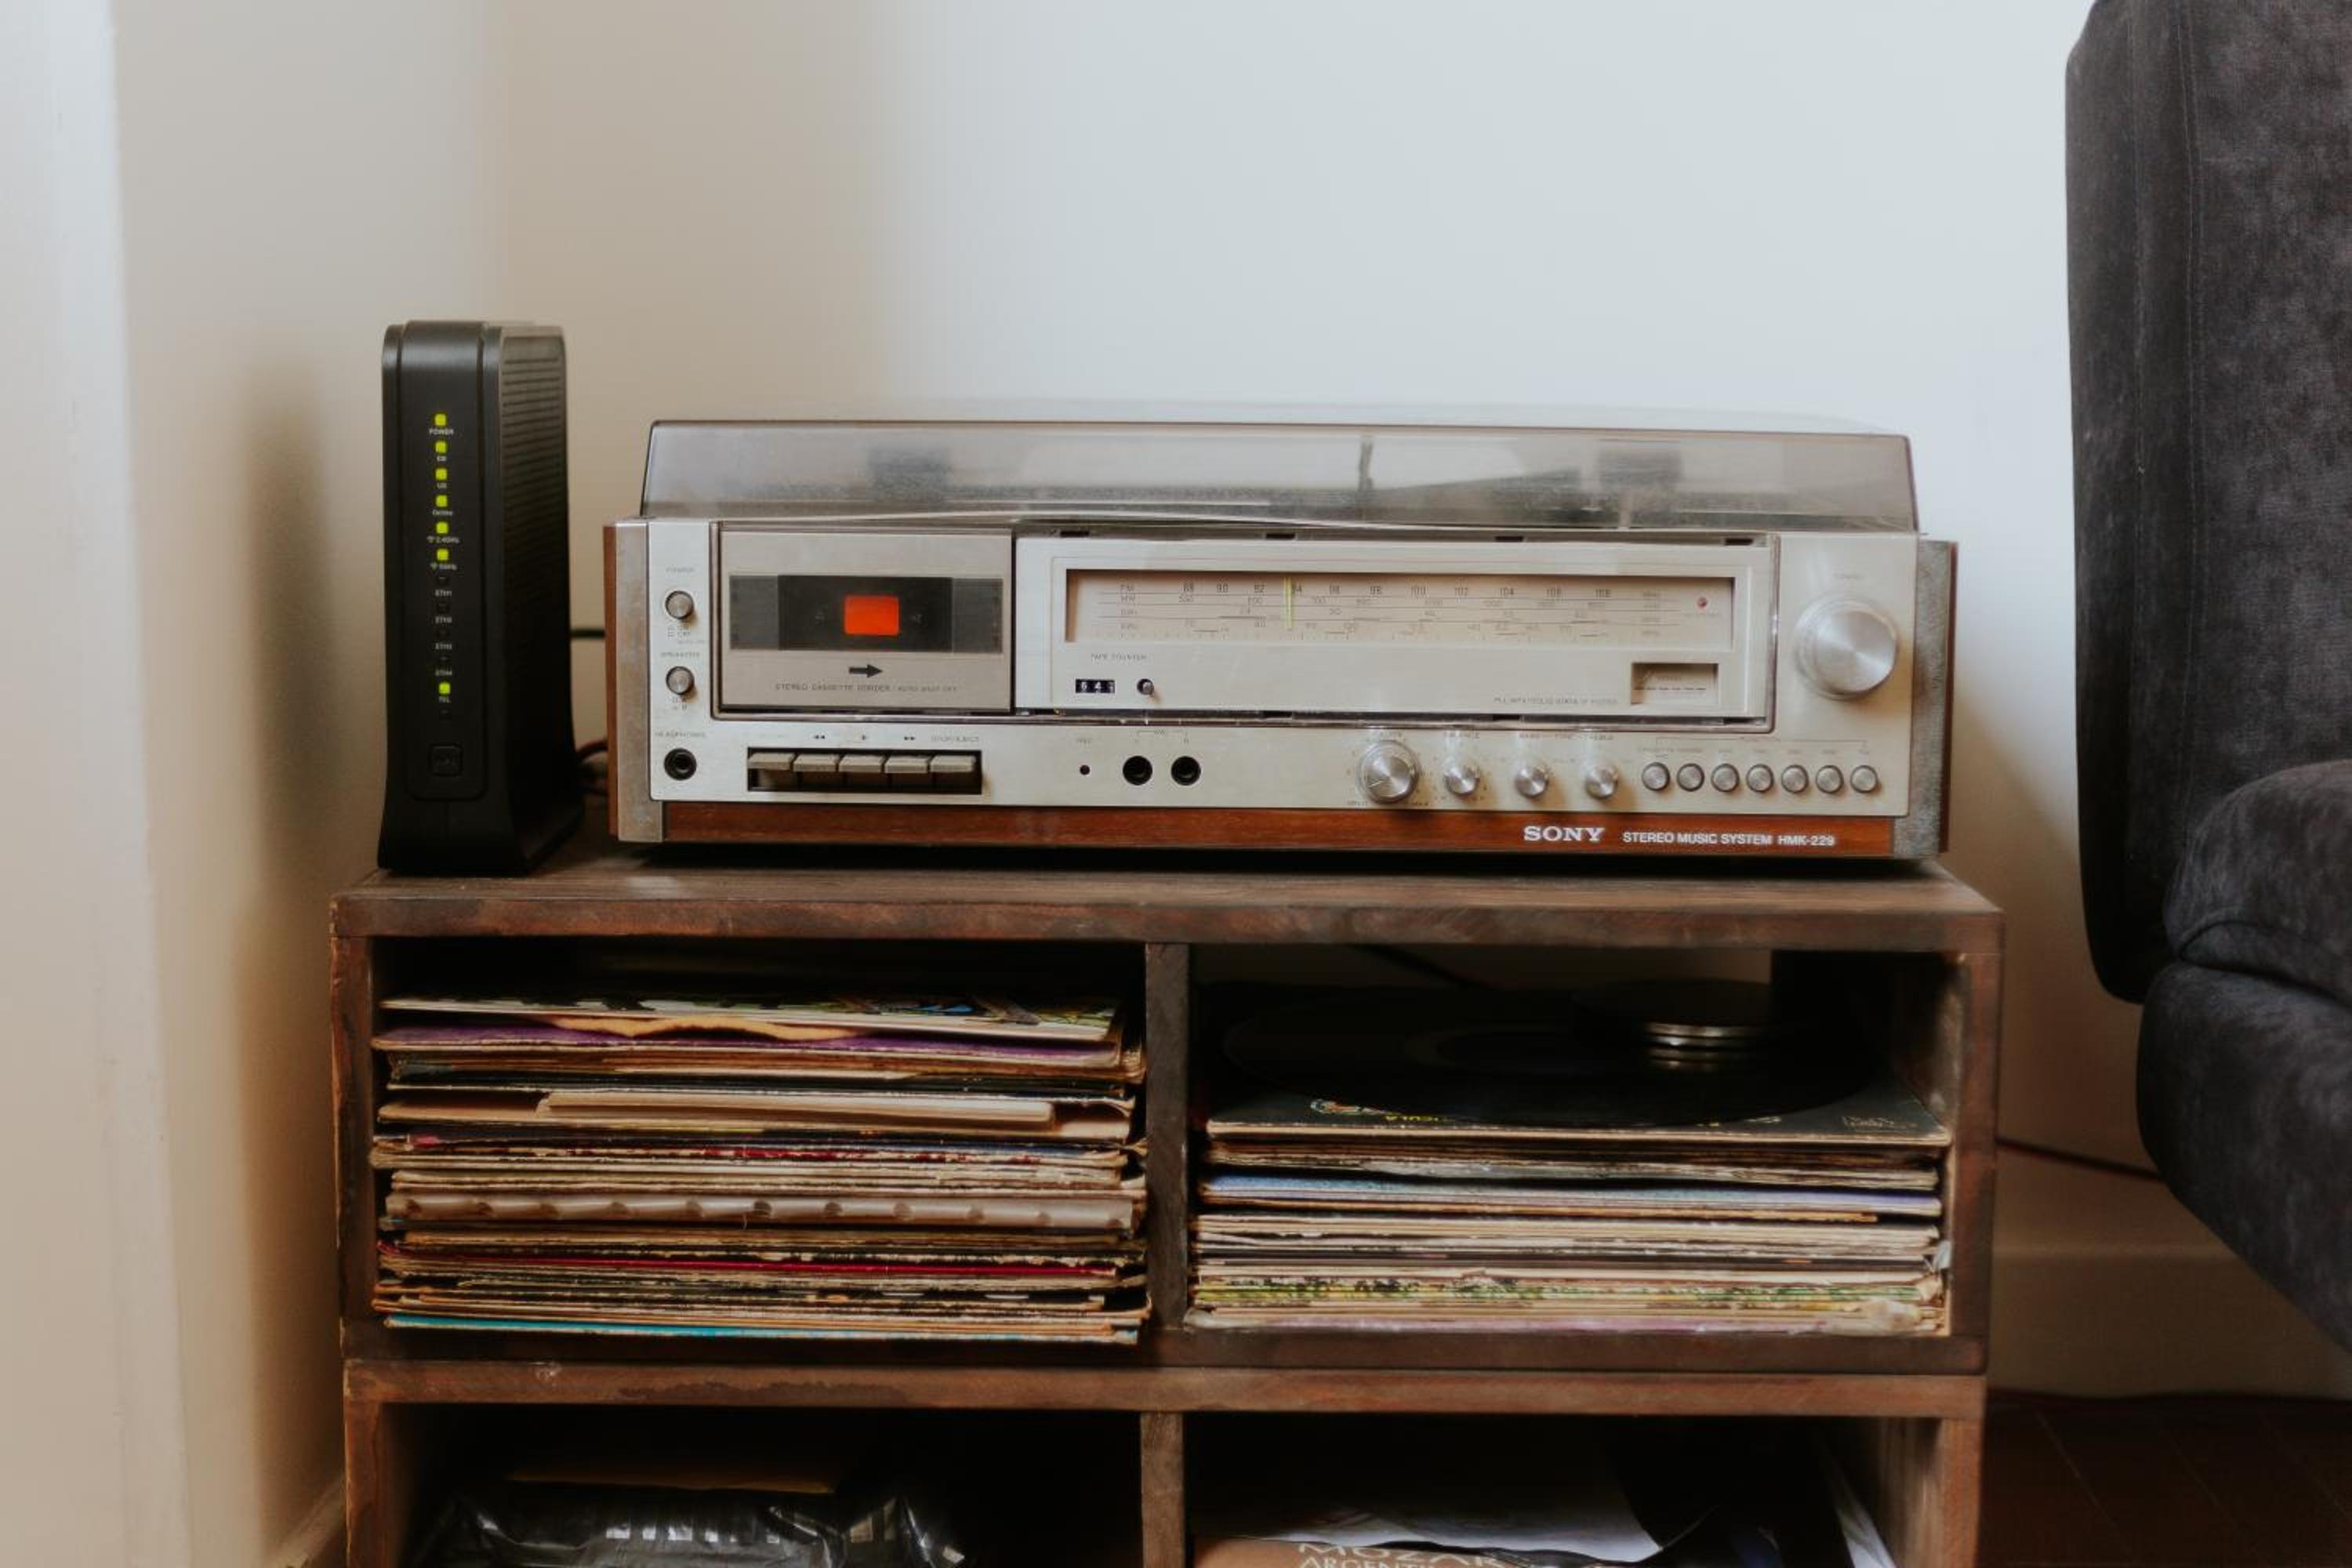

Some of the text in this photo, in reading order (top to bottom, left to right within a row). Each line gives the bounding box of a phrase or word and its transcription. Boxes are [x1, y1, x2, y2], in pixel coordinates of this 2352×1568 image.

[1523, 826, 1605, 842] SONY
[1622, 831, 1835, 847] STEREO MUSIC SYSTEM HMK-229
